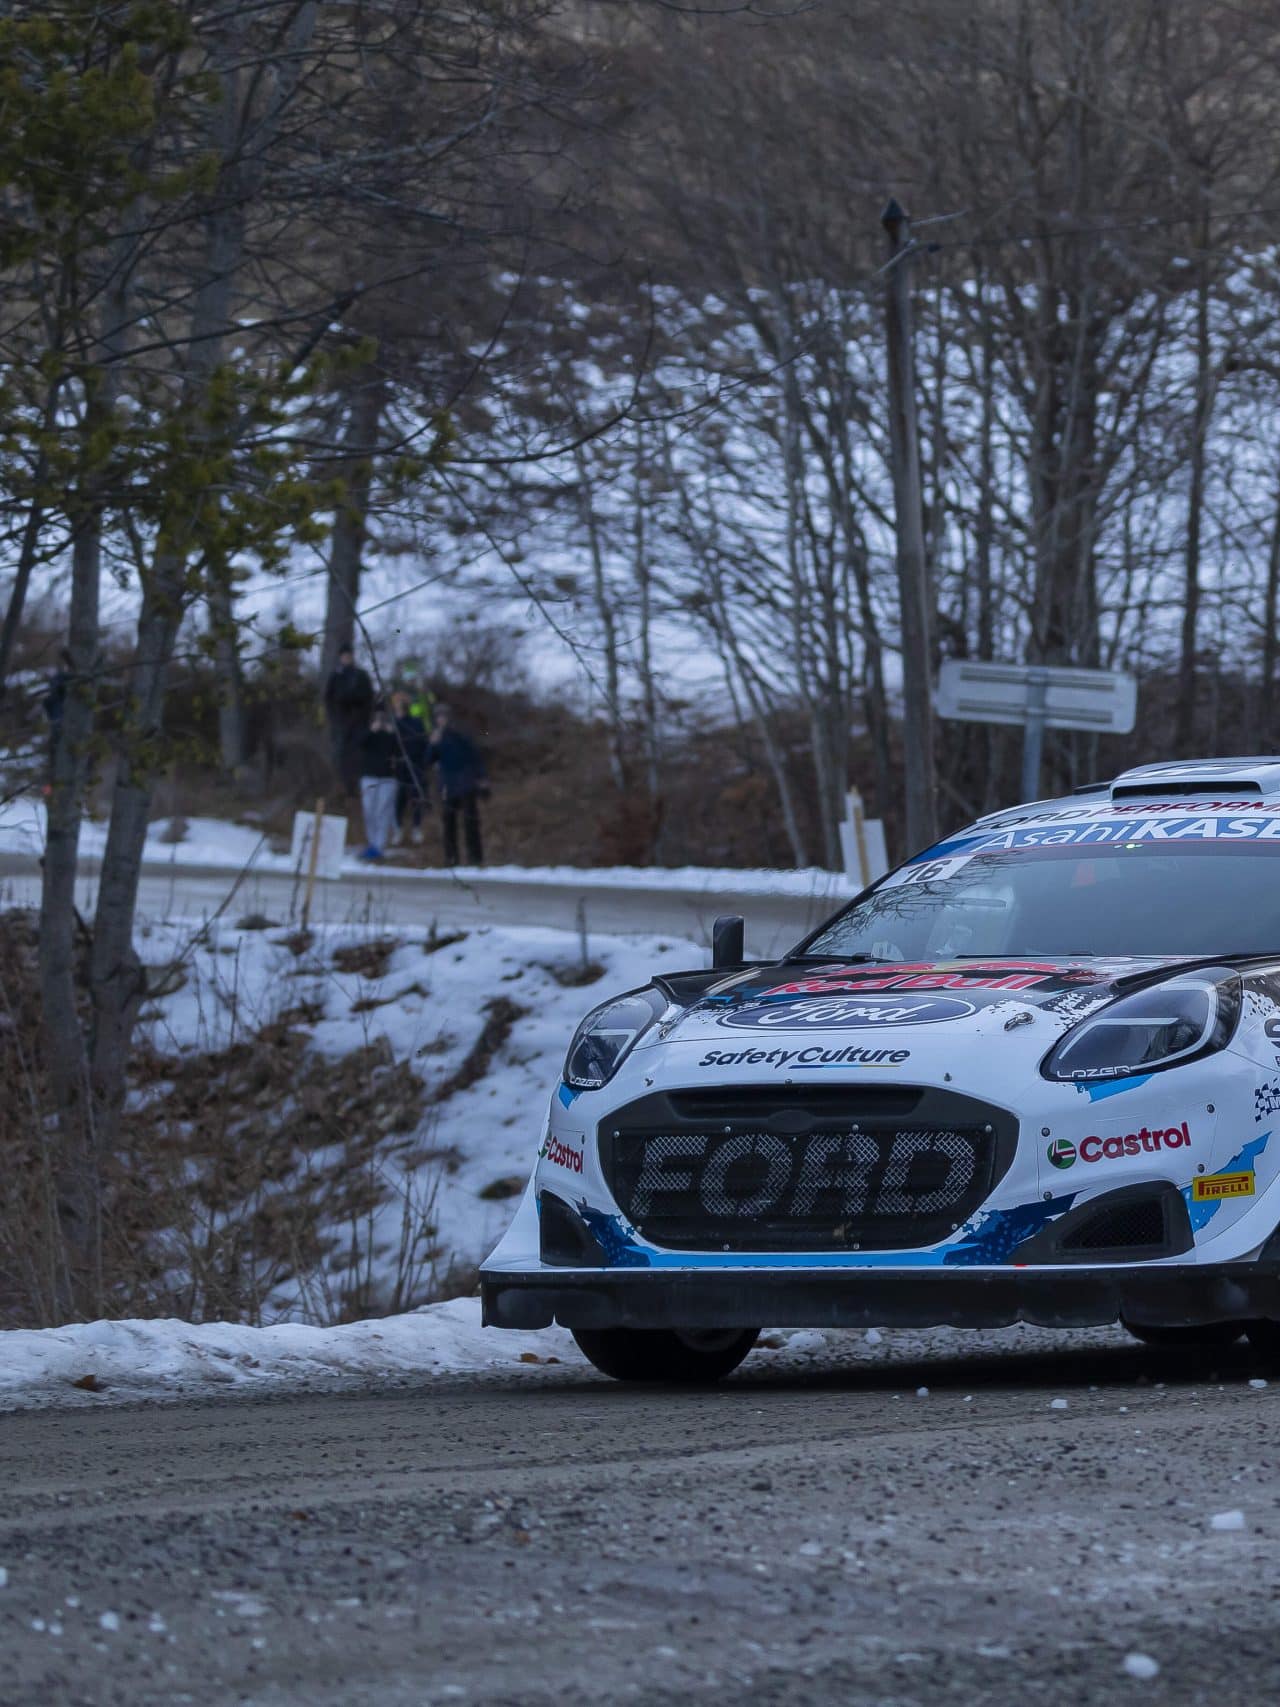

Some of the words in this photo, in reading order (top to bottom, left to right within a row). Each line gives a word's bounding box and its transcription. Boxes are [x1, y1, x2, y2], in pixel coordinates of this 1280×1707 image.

[903, 859, 953, 884] 16
[753, 974, 917, 998] Red
[889, 973, 1054, 991] Bull
[757, 997, 937, 1024] Ford
[698, 1046, 911, 1070] SafetyCulture
[1080, 1121, 1191, 1162] Castrol
[547, 1136, 584, 1174] Castrol
[630, 1131, 976, 1217] FORD
[1198, 1176, 1249, 1197] PIRELLI
